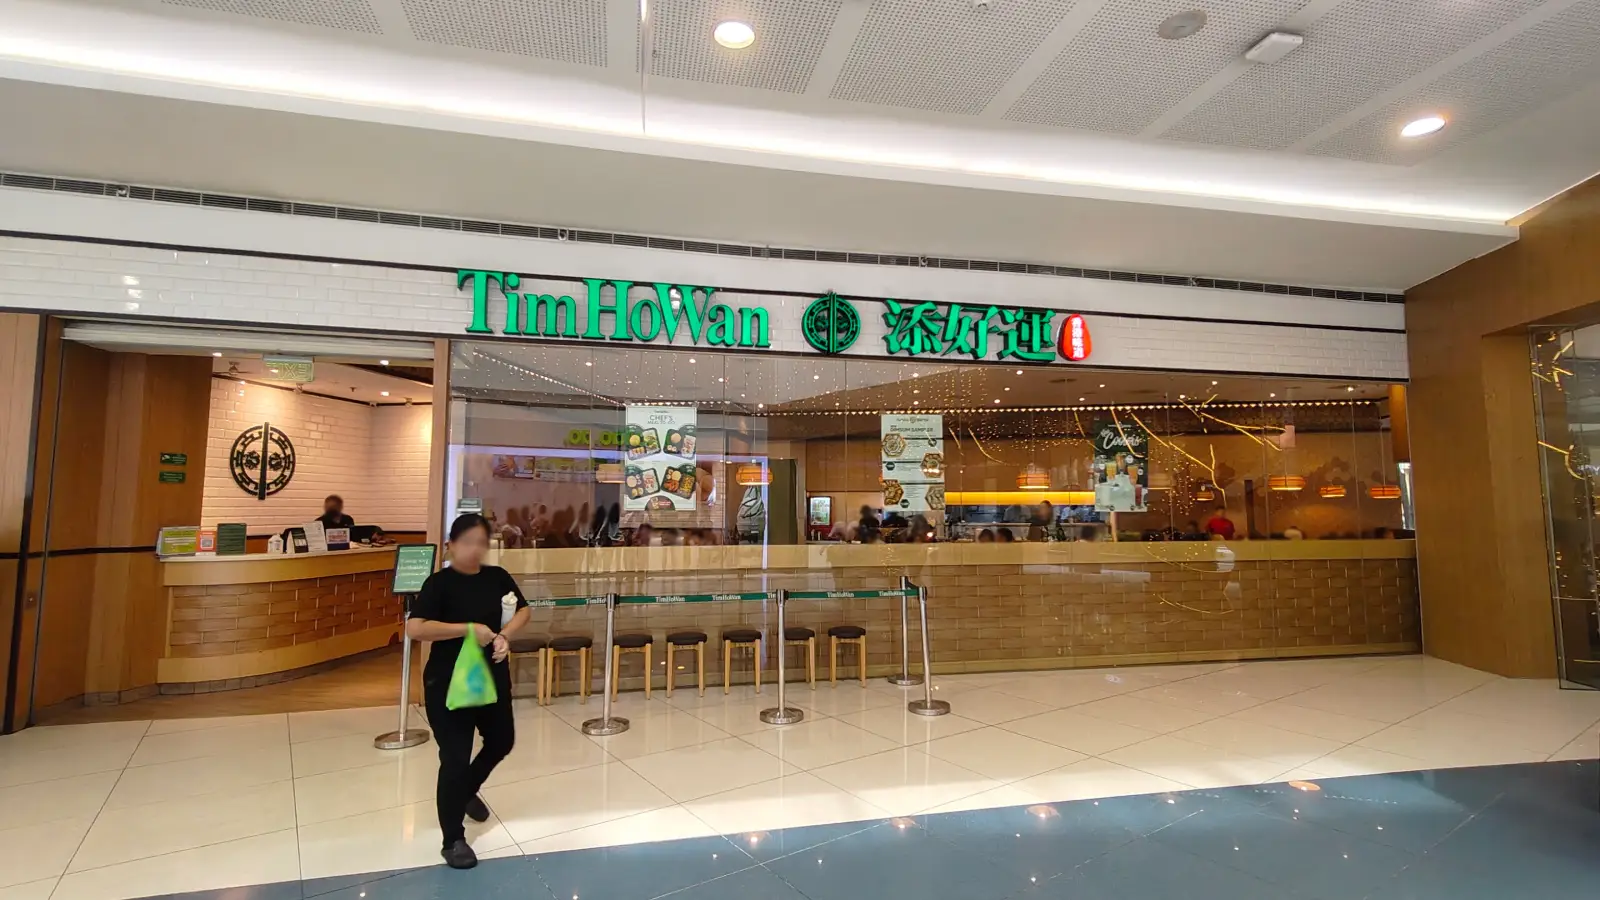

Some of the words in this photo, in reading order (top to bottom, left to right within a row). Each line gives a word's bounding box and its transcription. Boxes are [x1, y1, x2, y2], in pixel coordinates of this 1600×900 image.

[457, 269, 771, 348] TimHoWan
[882, 298, 1058, 362] 添好運
